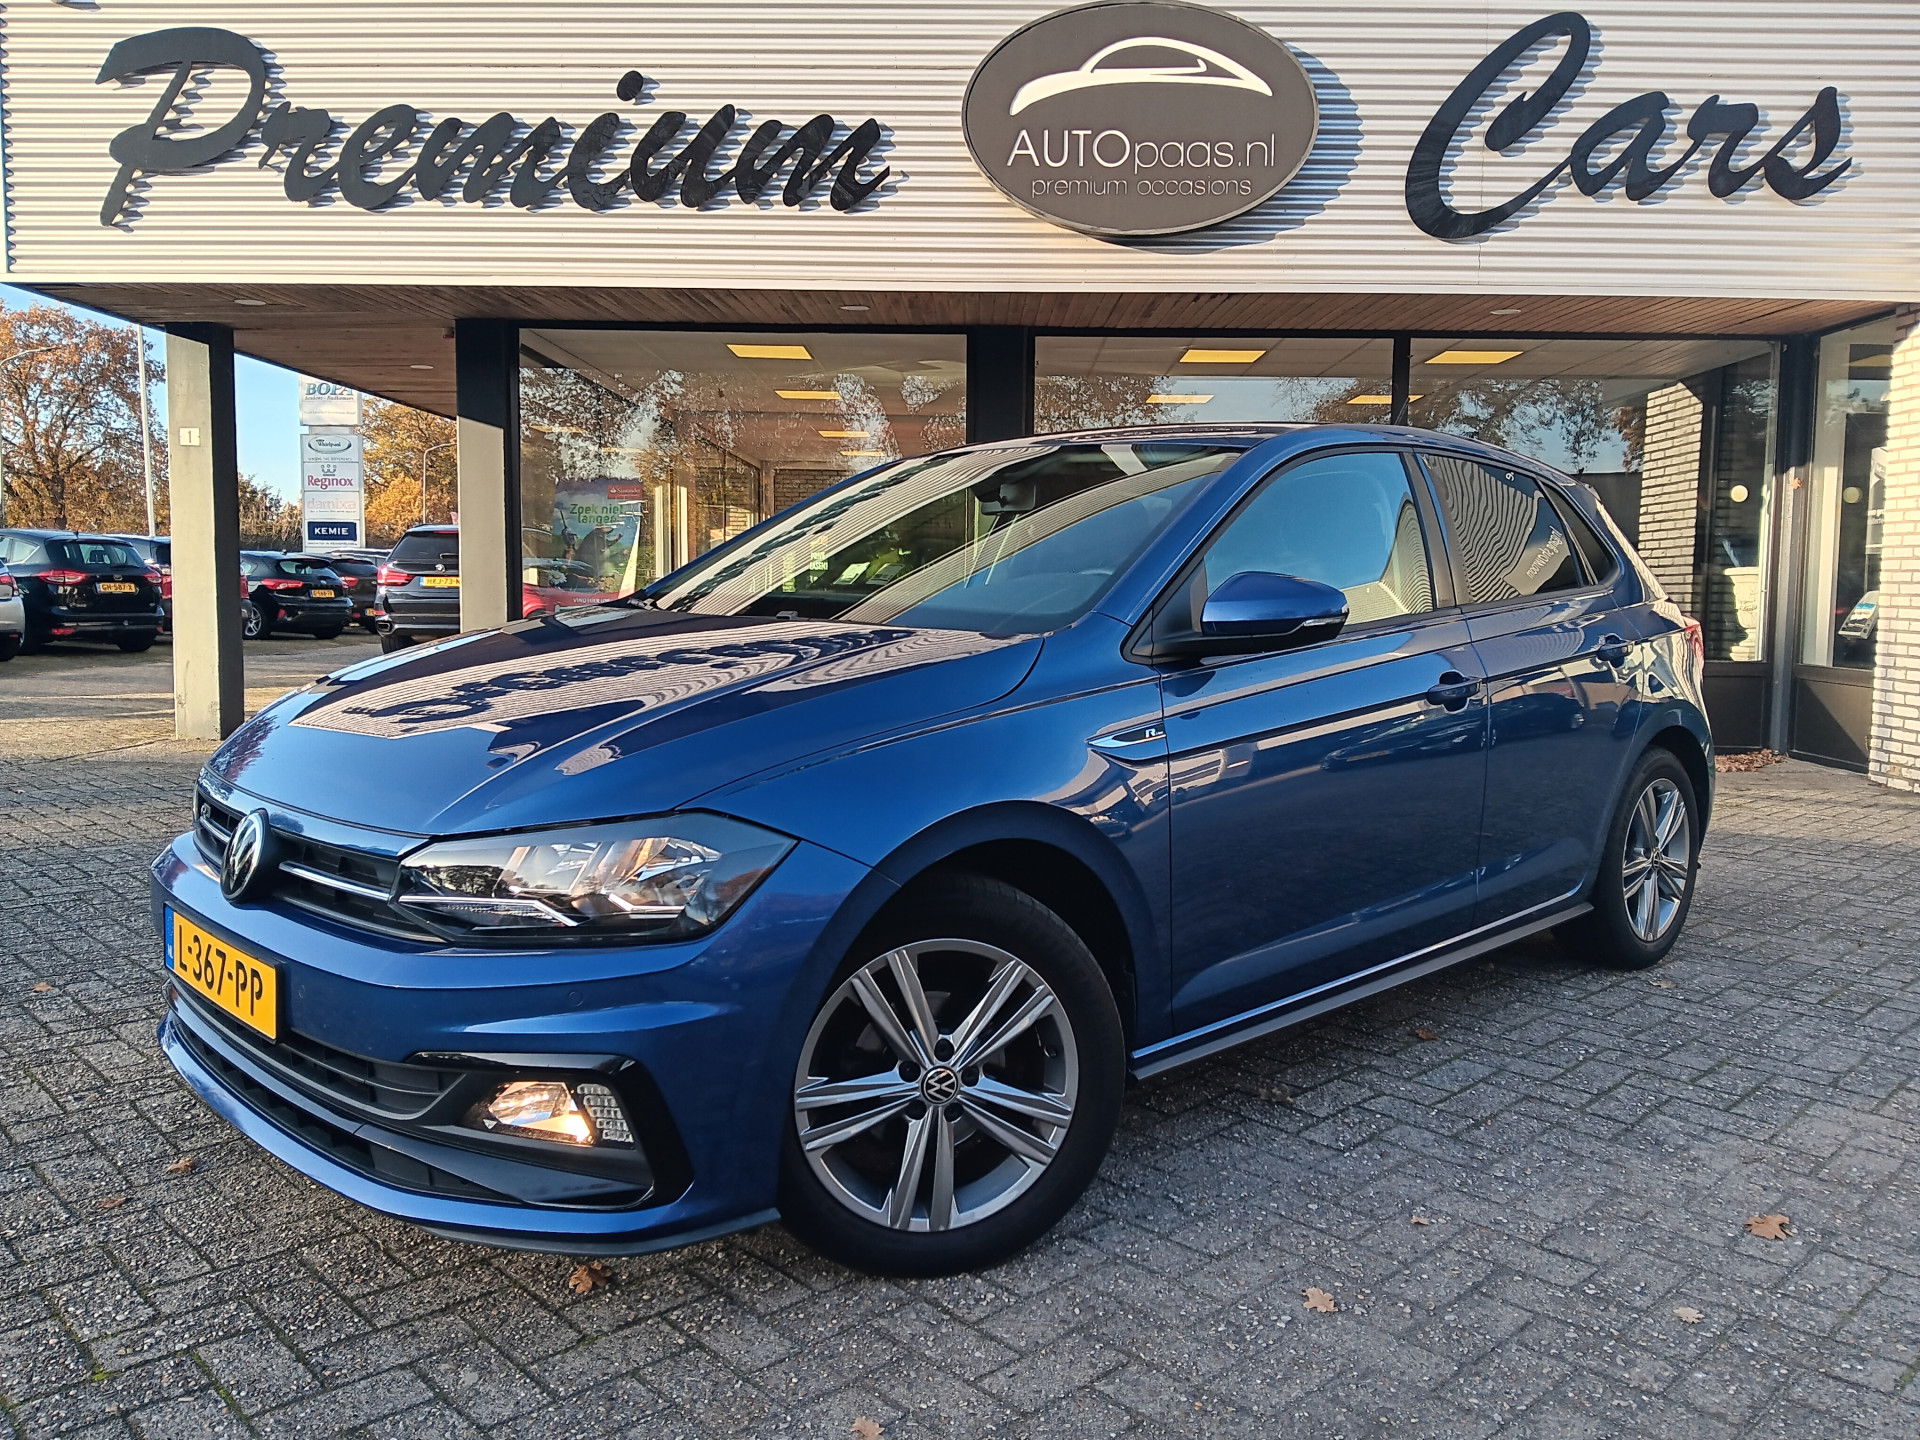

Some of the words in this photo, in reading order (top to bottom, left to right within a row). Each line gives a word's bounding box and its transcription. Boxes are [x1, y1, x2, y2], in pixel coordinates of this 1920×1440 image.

[96, 27, 890, 226] Premium
[1405, 11, 1852, 241] Cars
[1007, 129, 1275, 174] AUTOpaas.nl
[1032, 175, 1128, 198] premium
[1137, 175, 1252, 196] occasions
[307, 474, 353, 490] Reginox
[569, 503, 597, 514] Zoek
[314, 527, 349, 535] KEMIE
[179, 924, 263, 1017] L-367-PP
